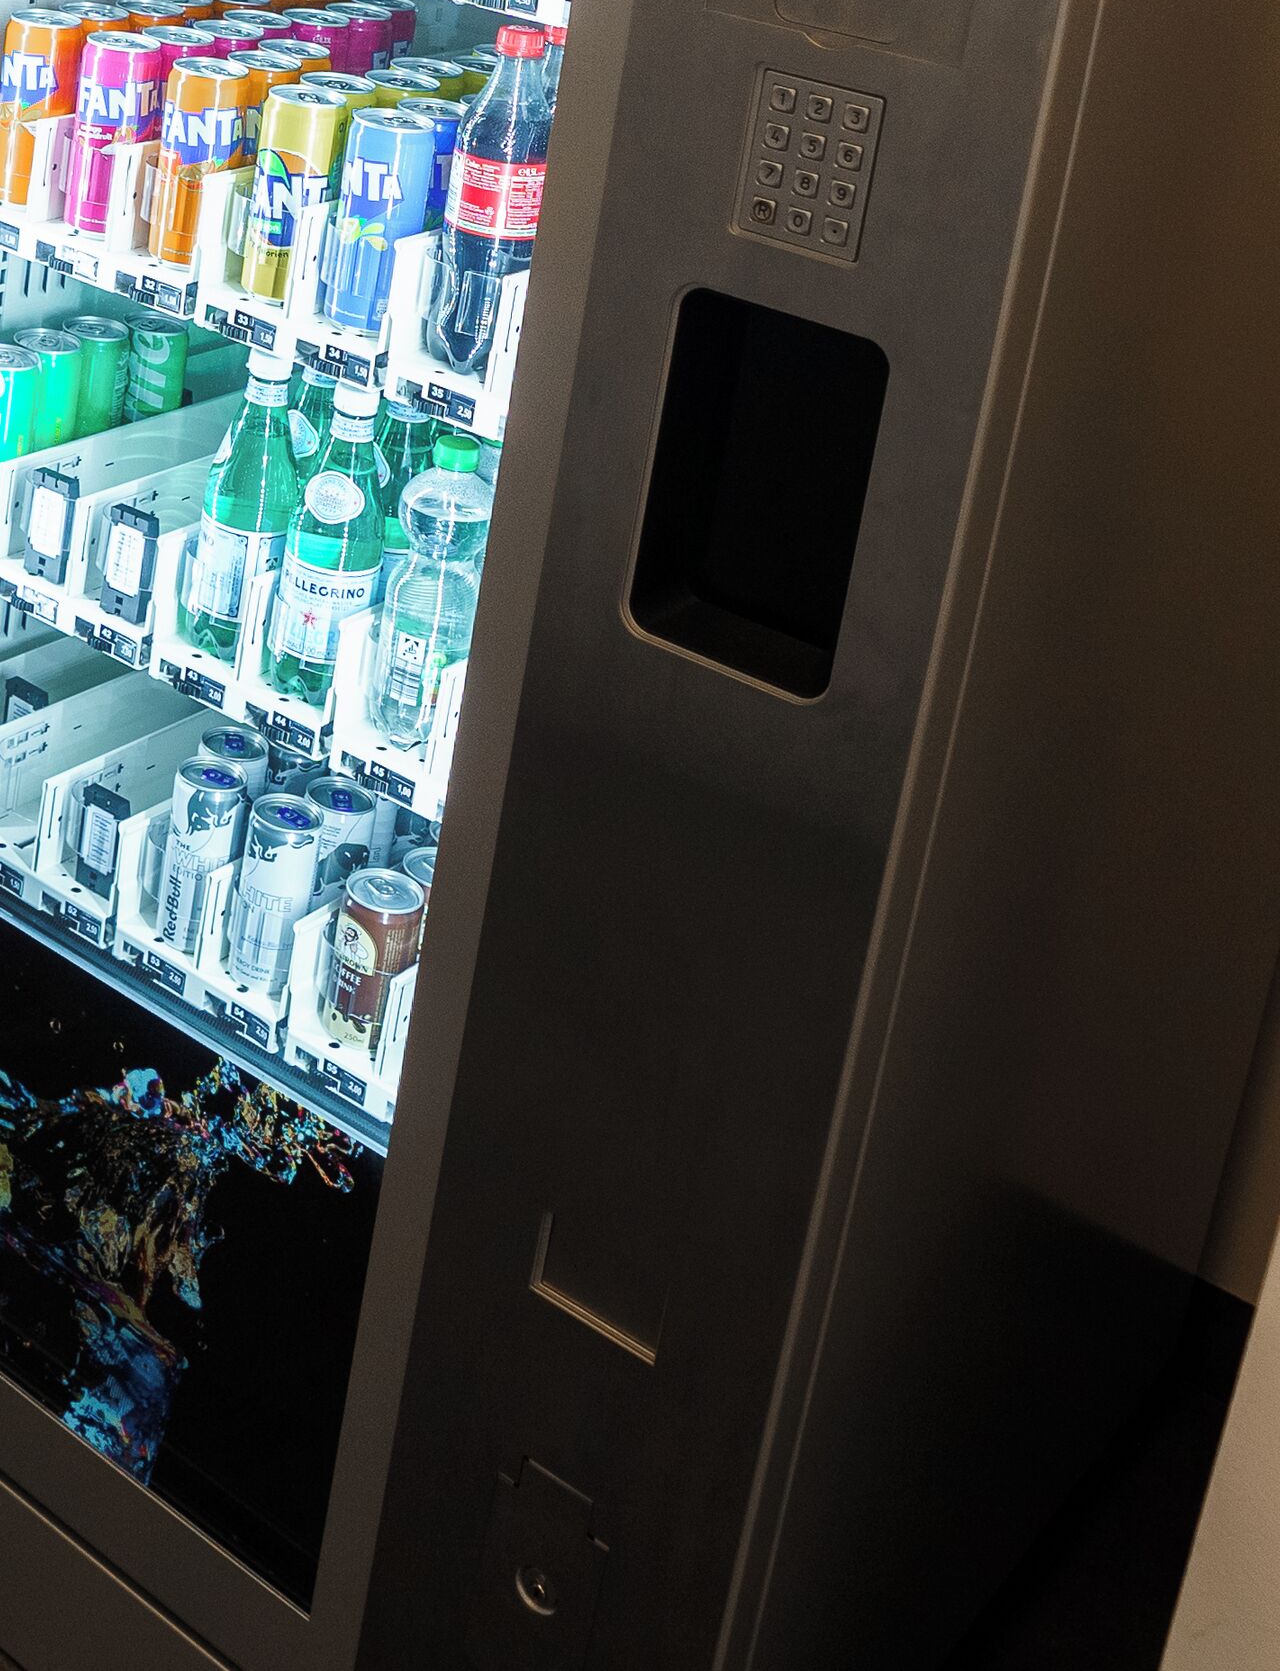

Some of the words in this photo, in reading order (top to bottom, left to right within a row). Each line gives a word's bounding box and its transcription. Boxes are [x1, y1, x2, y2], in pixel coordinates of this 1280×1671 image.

[1, 51, 57, 91] NTA
[78, 77, 158, 120] FANTA
[815, 102, 825, 115] 2
[851, 112, 860, 125] 3
[164, 101, 244, 146] FANTA
[771, 131, 780, 143] 4
[807, 140, 817, 153] 5
[843, 150, 853, 163] 6
[342, 157, 403, 202] NTA
[766, 167, 775, 180] 7
[801, 177, 810, 190] 8
[837, 188, 846, 201] 9
[144, 280, 156, 291] 32
[237, 313, 249, 326] 33
[328, 347, 341, 359] 34
[431, 386, 444, 399] 35
[102, 628, 113, 640] 42
[186, 669, 199, 682] 43
[274, 714, 287, 727] 44
[297, 734, 311, 749] 2,00
[372, 764, 386, 777] 45
[397, 783, 412, 799] 1,00
[175, 839, 191, 851] THE
[67, 905, 78, 916] 52
[150, 954, 161, 967] 53
[234, 1006, 245, 1019] 54
[326, 1062, 339, 1075] 55
